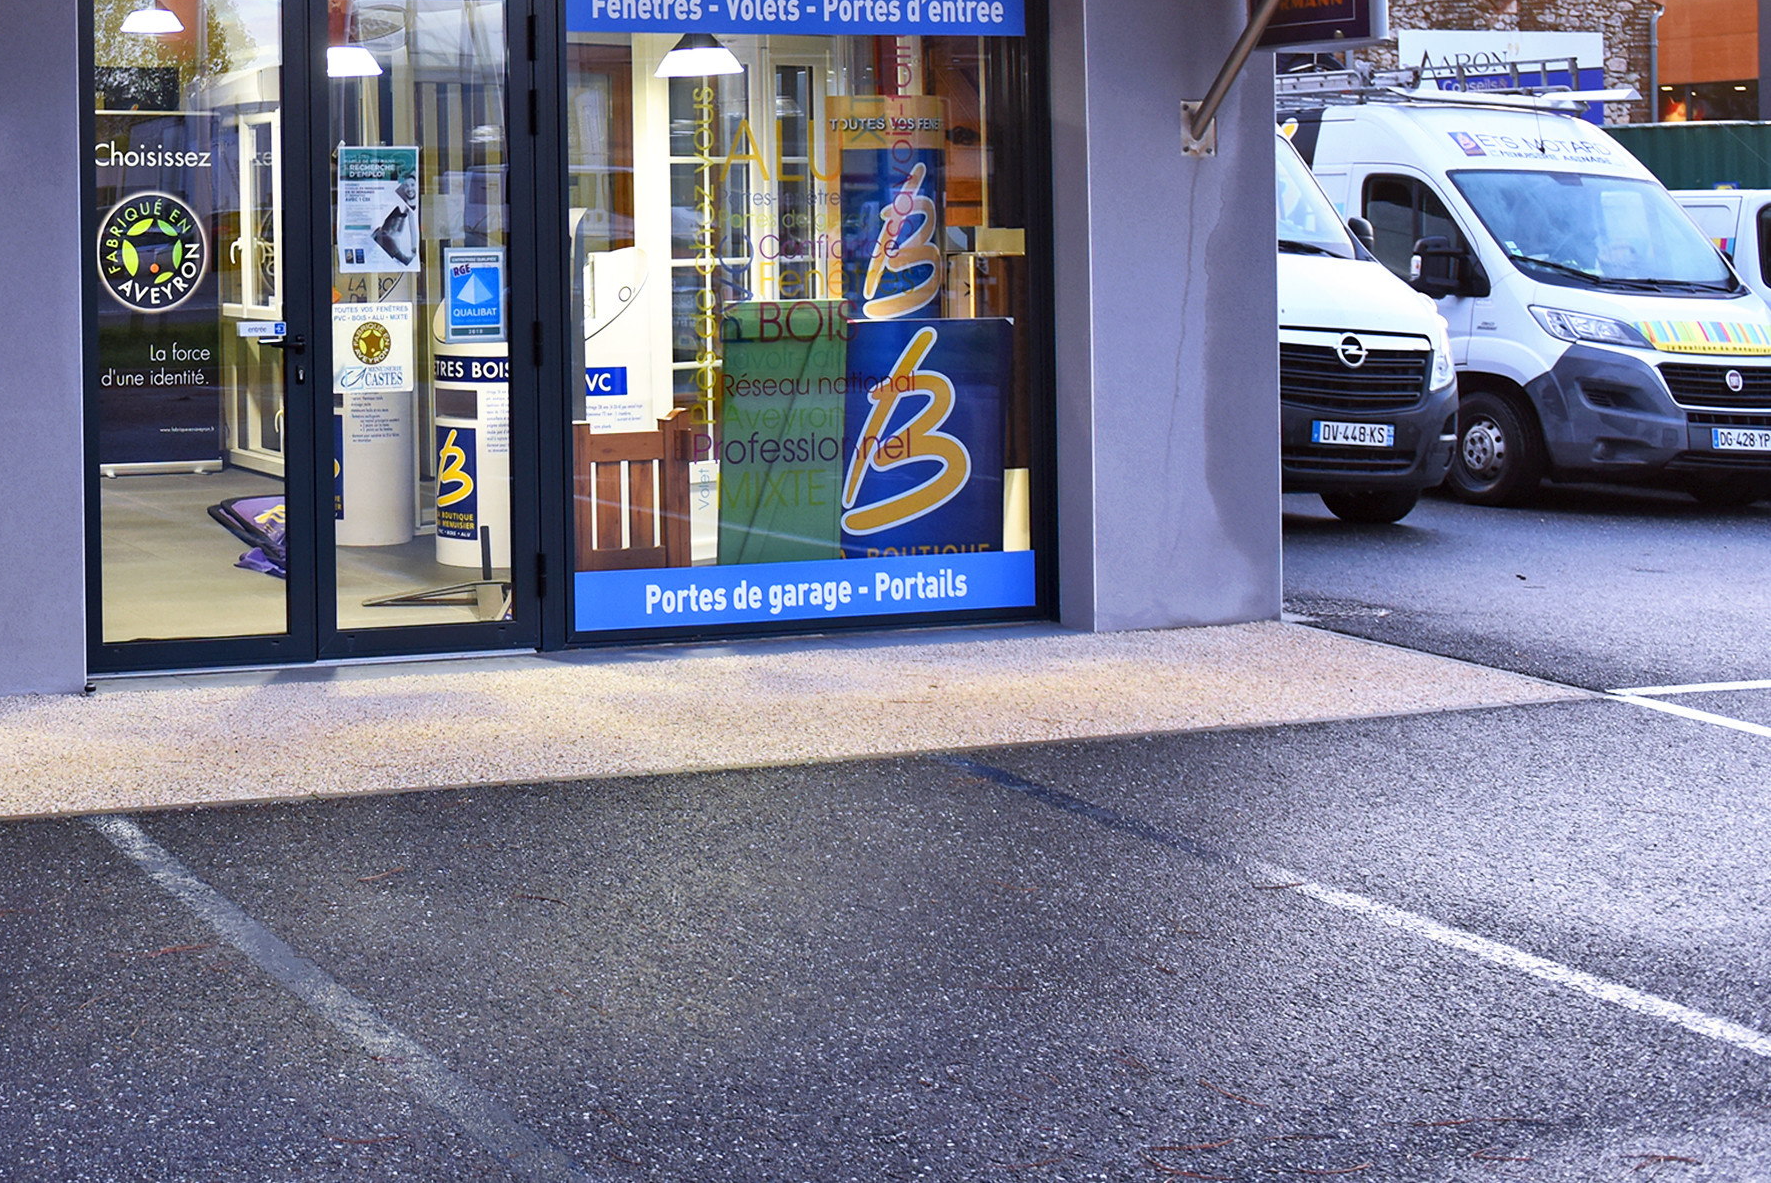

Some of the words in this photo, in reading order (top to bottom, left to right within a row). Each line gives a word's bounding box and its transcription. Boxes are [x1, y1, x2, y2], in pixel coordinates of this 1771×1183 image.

[829, 118, 885, 131] TOUTES
[888, 117, 916, 130] VOS
[94, 140, 212, 168] Choisissez
[719, 119, 843, 182] ALU
[1475, 133, 1519, 150] ETS
[1521, 135, 1612, 156] MOTARD
[107, 199, 163, 275] FABRIQUÉ
[169, 208, 193, 234] EN
[758, 233, 900, 262] Confiance
[118, 243, 201, 305] AVEYRON
[453, 263, 471, 277] RGE
[759, 259, 916, 299] Fenêtres
[376, 304, 409, 313] FENÊTRES
[453, 307, 497, 318] QUALIBAT
[758, 299, 859, 344] BOIS
[150, 343, 166, 361] La
[172, 341, 211, 361] force
[100, 369, 145, 387] d'une
[150, 367, 210, 387] identité.
[365, 370, 404, 387] CASTES
[719, 373, 811, 397] Réseau
[818, 370, 917, 395] national
[724, 405, 846, 434] Aveyron
[692, 428, 912, 465] Professionnel
[715, 467, 827, 510] MIXTE
[644, 584, 728, 616] Portes
[732, 579, 764, 610] de
[768, 577, 852, 616] garage
[874, 567, 968, 602] Portails
